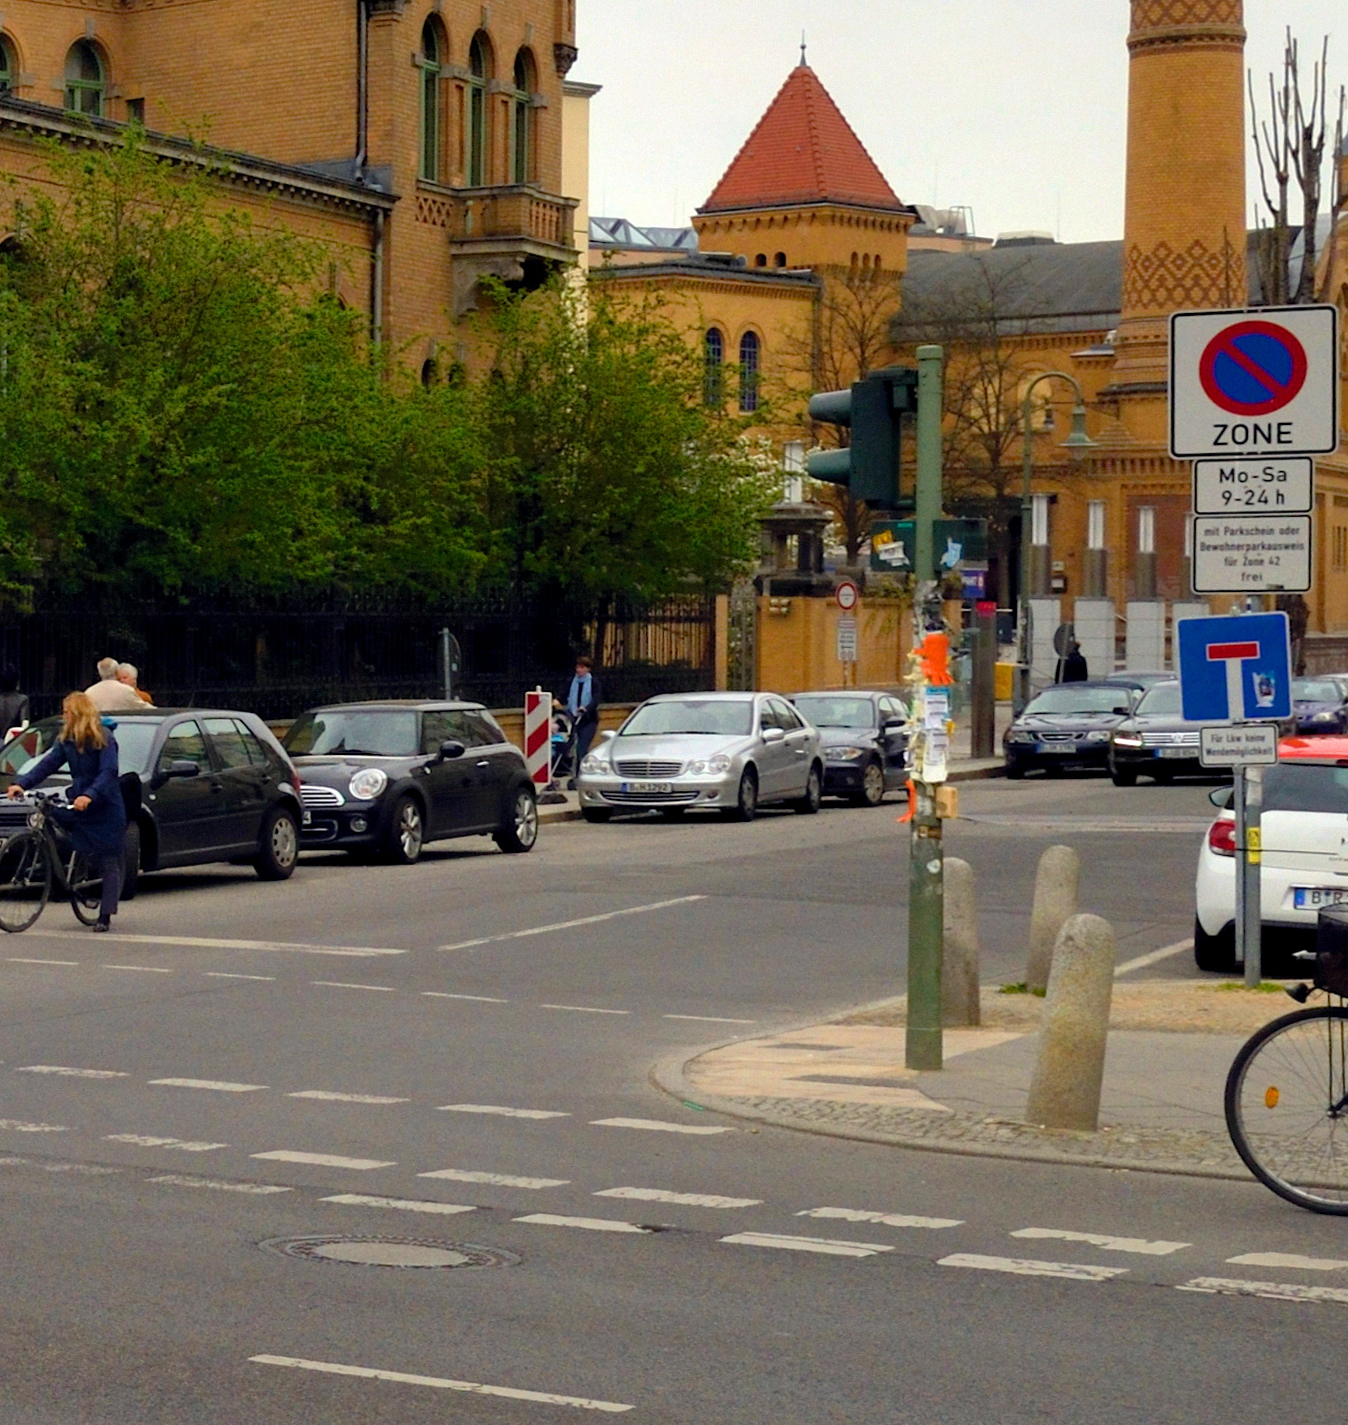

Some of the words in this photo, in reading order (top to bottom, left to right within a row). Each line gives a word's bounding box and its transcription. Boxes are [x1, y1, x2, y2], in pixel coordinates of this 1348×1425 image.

[1212, 422, 1293, 446] ZONE
[1219, 467, 1288, 483] Mo-Sa
[1221, 489, 1269, 506] 9-24
[1276, 489, 1285, 505] h
[1203, 527, 1220, 536] mit
[1223, 526, 1275, 536] Parkschein
[1278, 526, 1301, 536] oder
[1199, 540, 1305, 554] Bewohnerparkausweis
[1224, 557, 1238, 566] für
[1242, 556, 1265, 566] Zone
[1268, 556, 1281, 566] 42
[1241, 572, 1263, 582] frei
[1311, 891, 1322, 904] B
